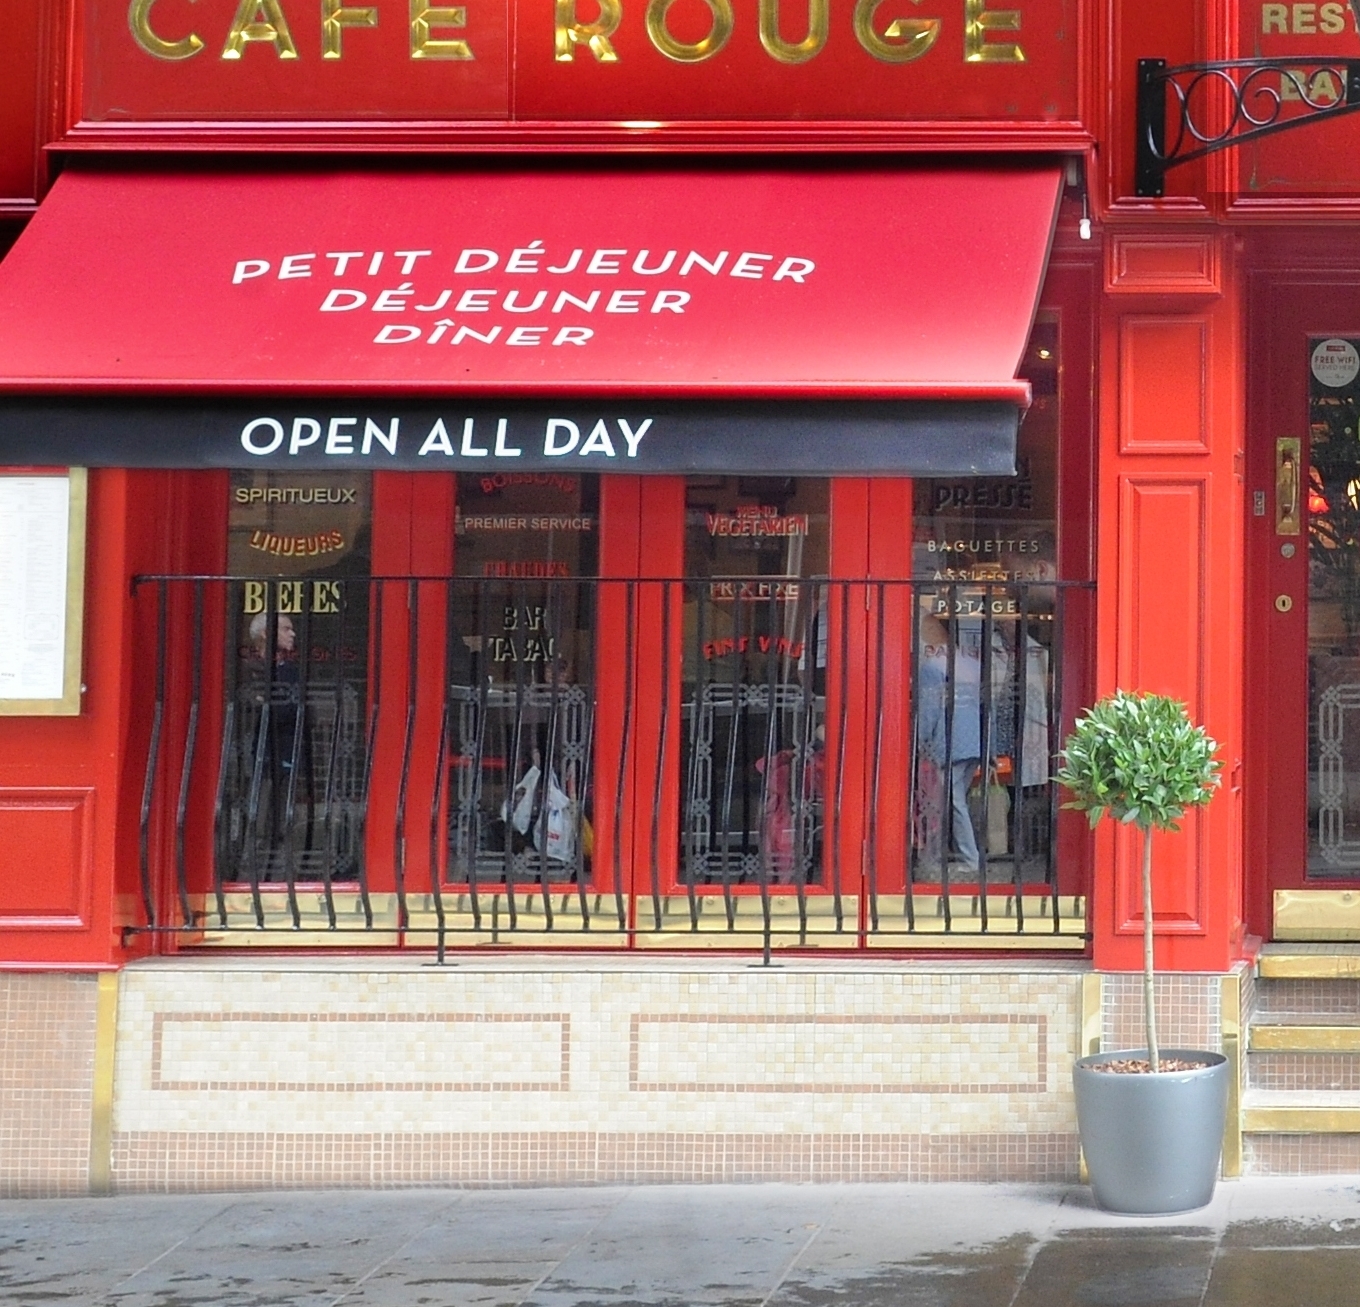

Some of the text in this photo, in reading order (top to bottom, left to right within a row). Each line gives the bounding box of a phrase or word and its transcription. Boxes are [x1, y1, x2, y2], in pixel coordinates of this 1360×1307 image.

[554, 0, 1026, 63] ROUGE
[231, 240, 816, 284] PETIT DÉJEUNER
[319, 283, 691, 315] DÉJEUNER
[373, 319, 595, 347] DÎNER
[240, 418, 653, 458] OPEN ALL DAY
[236, 488, 357, 504] SPIRITUEUX
[465, 518, 591, 530] PREMIER SERVICE
[250, 529, 345, 557] LIQUEURS
[927, 540, 1039, 553] BAGUETTES
[710, 582, 754, 598] PRX
